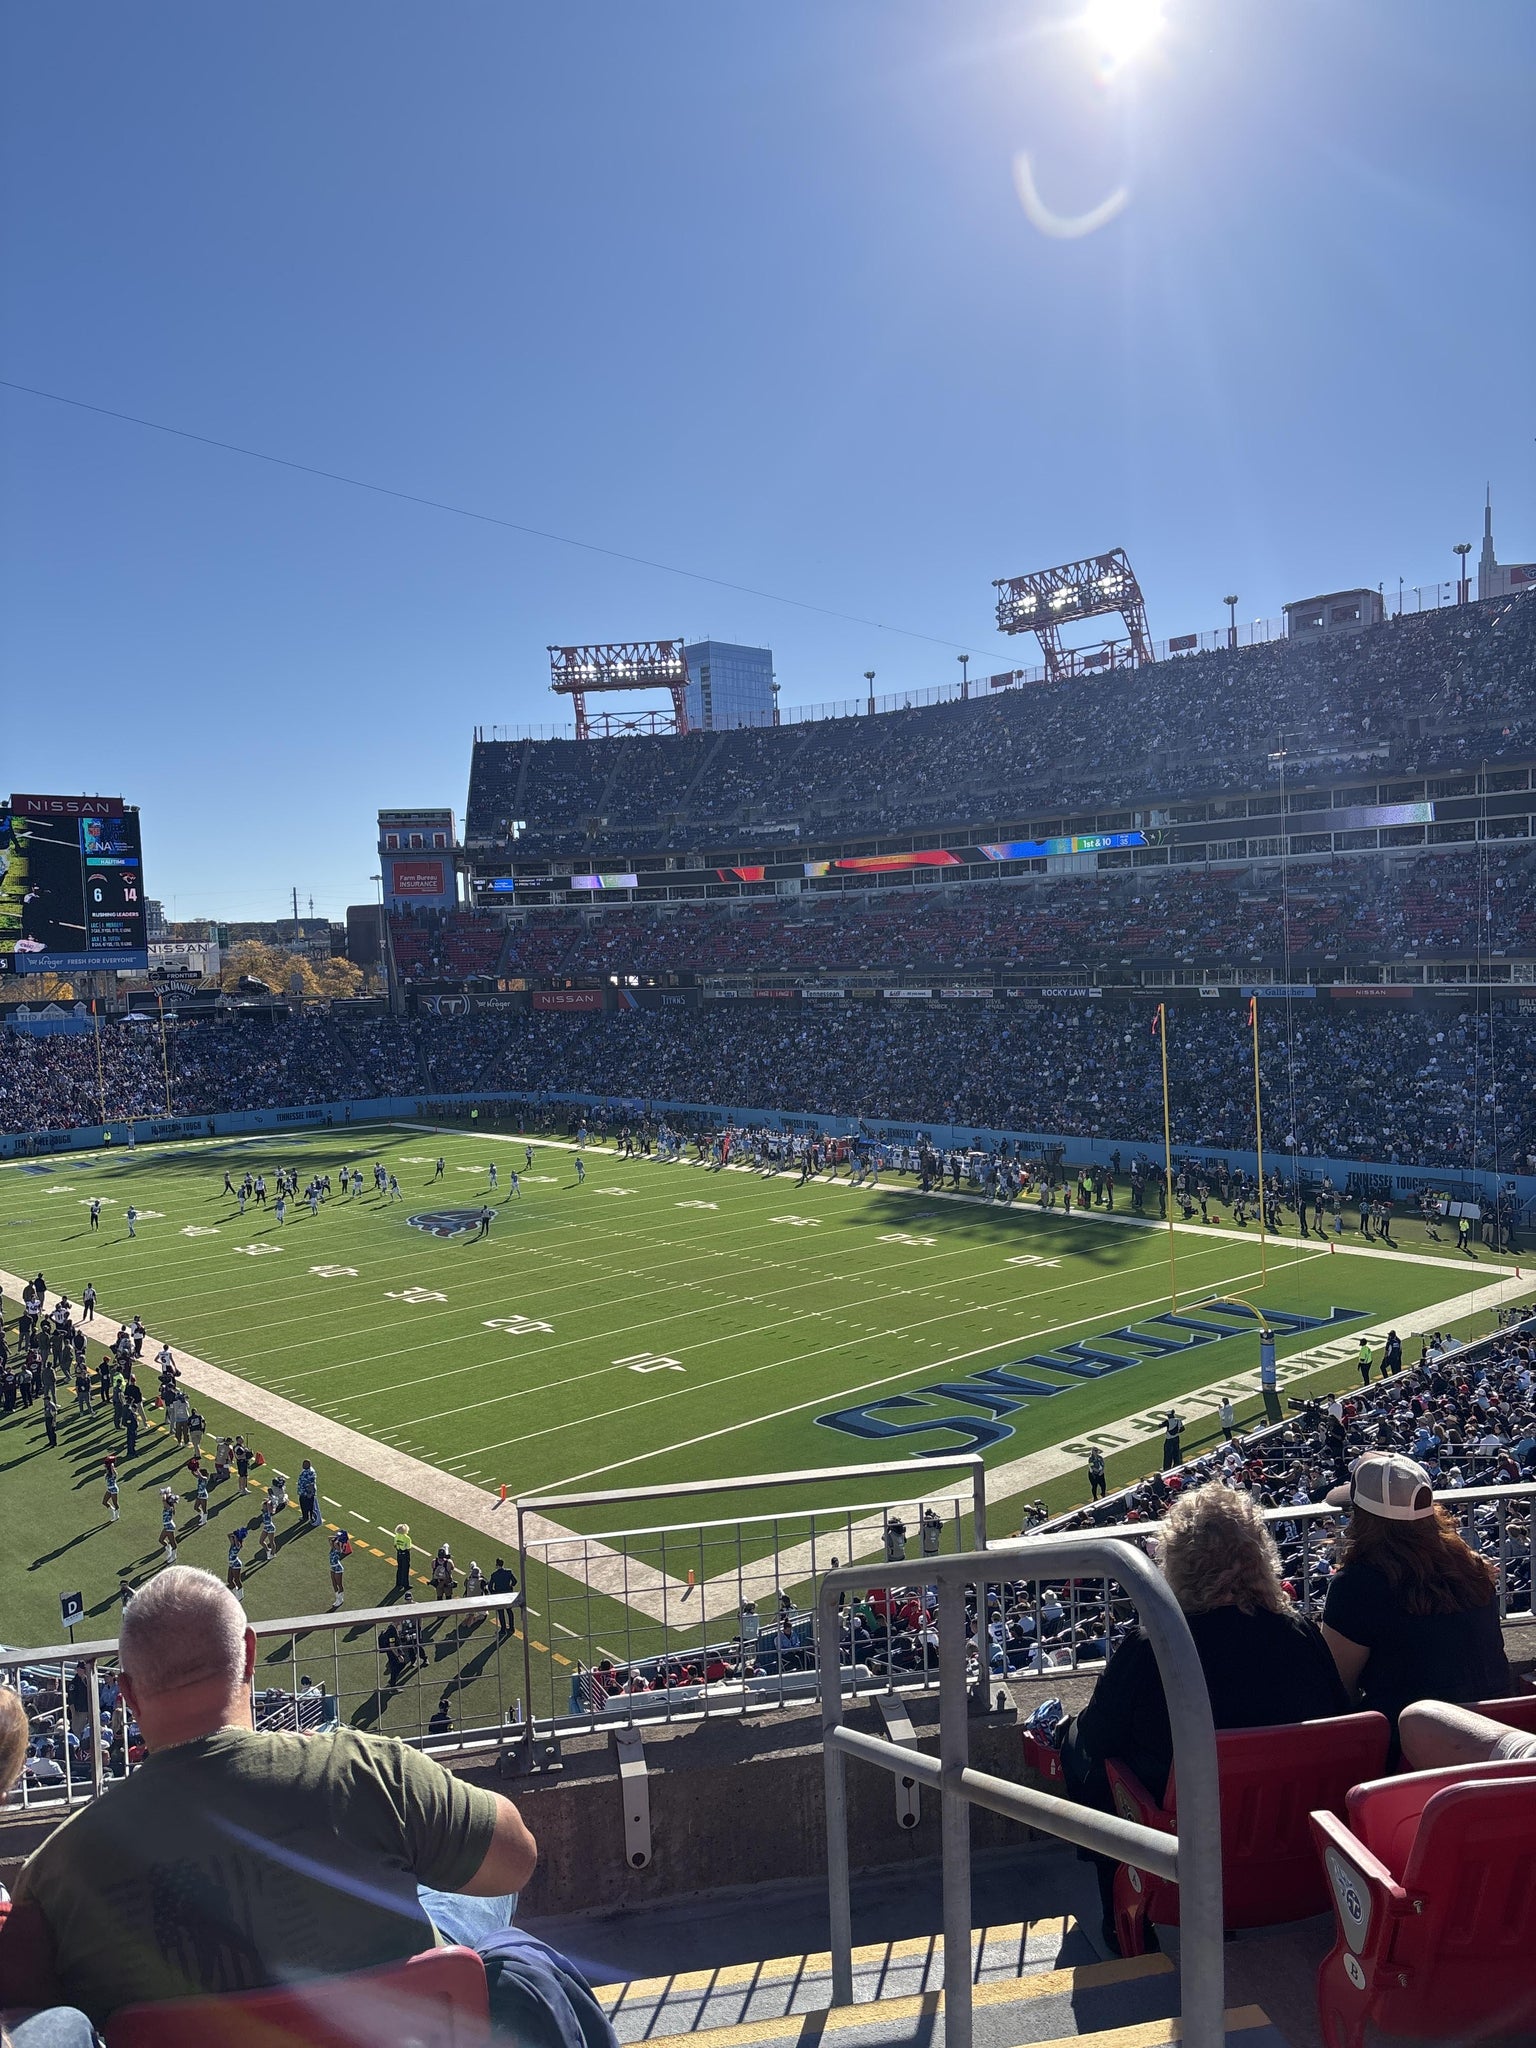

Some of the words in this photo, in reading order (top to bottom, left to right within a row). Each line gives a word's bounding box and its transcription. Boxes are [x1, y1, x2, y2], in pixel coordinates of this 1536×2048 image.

[28, 800, 110, 813] NISSAN
[1083, 839, 1094, 848] 1st
[1095, 839, 1101, 847] &
[1102, 837, 1112, 846] 10
[93, 887, 103, 902] 6
[123, 887, 138, 901] 14
[147, 944, 208, 953] NISSAN
[38, 956, 63, 969] Kroger
[153, 982, 170, 997] JACK
[1006, 989, 1025, 997] FedEx
[1042, 989, 1066, 997] ROCKY
[1069, 989, 1086, 997] LAW
[487, 997, 511, 1011] Kroger
[541, 995, 593, 1004] NISSAN
[660, 994, 686, 1005] TITANS
[276, 1111, 304, 1122] TENNESSEE
[1348, 1172, 1393, 1187] TENNESSEE
[875, 1233, 938, 1247] 20
[1004, 1254, 1063, 1268] 10
[383, 1286, 448, 1304] 30
[481, 1315, 554, 1335] 20
[611, 1352, 683, 1373] 10
[812, 1293, 1377, 1459] TITANS
[1178, 1382, 1255, 1408] ALL
[1060, 1432, 1131, 1458] US
[67, 1601, 78, 1614] D
[1350, 1961, 1359, 1981] B
